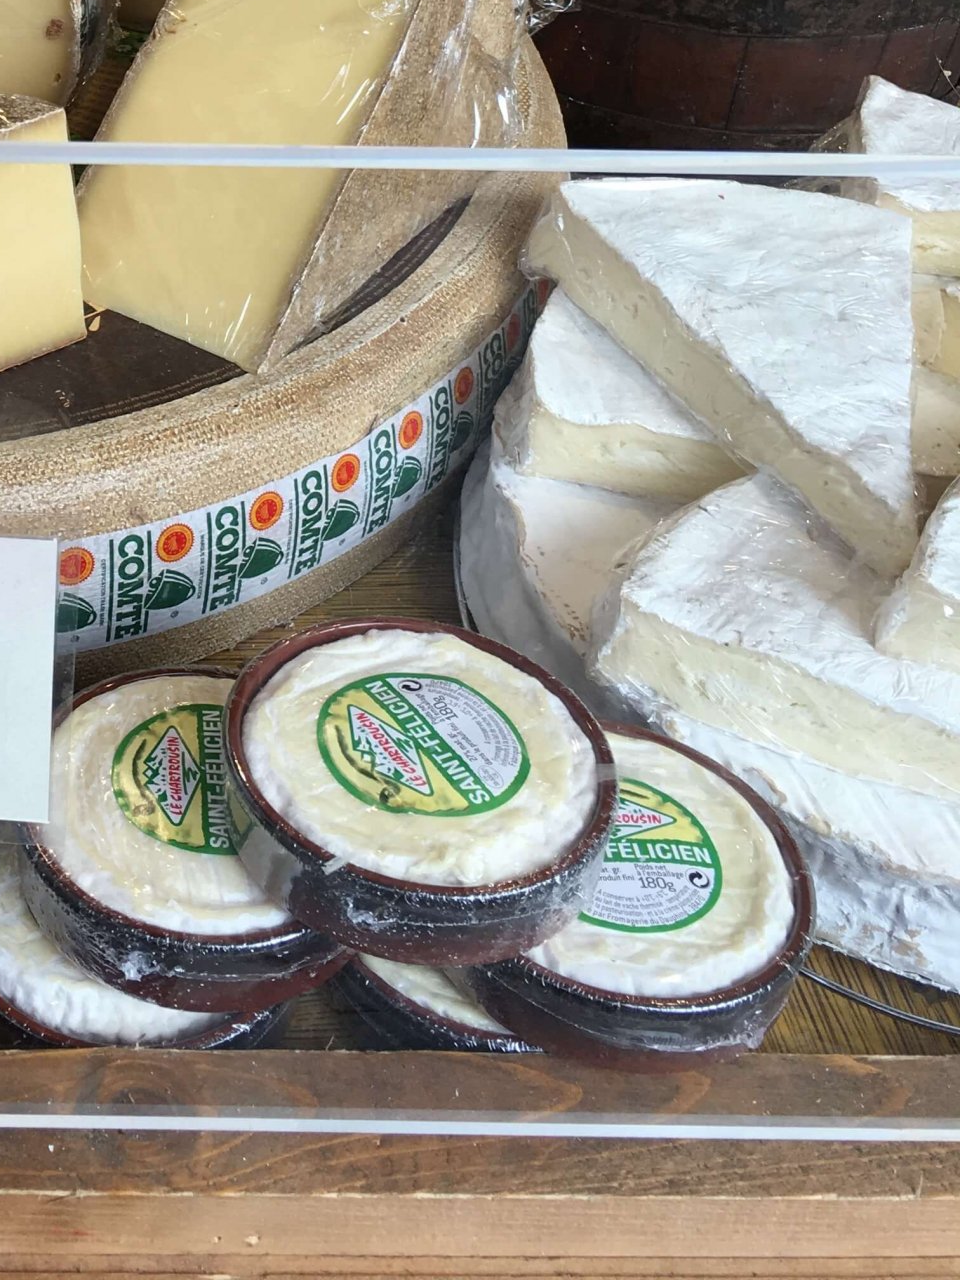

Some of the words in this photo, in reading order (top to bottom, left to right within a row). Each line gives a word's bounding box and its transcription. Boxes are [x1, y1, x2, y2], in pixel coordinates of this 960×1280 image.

[210, 505, 240, 612] COMTÉ
[114, 534, 145, 640] COMTÉ
[433, 696, 458, 721] 180g
[354, 712, 416, 775] CHARTROUSIN
[365, 680, 490, 805] SAINT-FÉLICIEN
[456, 730, 477, 750] produit
[167, 736, 182, 800] CHARTROUSIN
[411, 774, 427, 787] LE
[170, 800, 182, 816] LE
[638, 877, 676, 892] 180g
